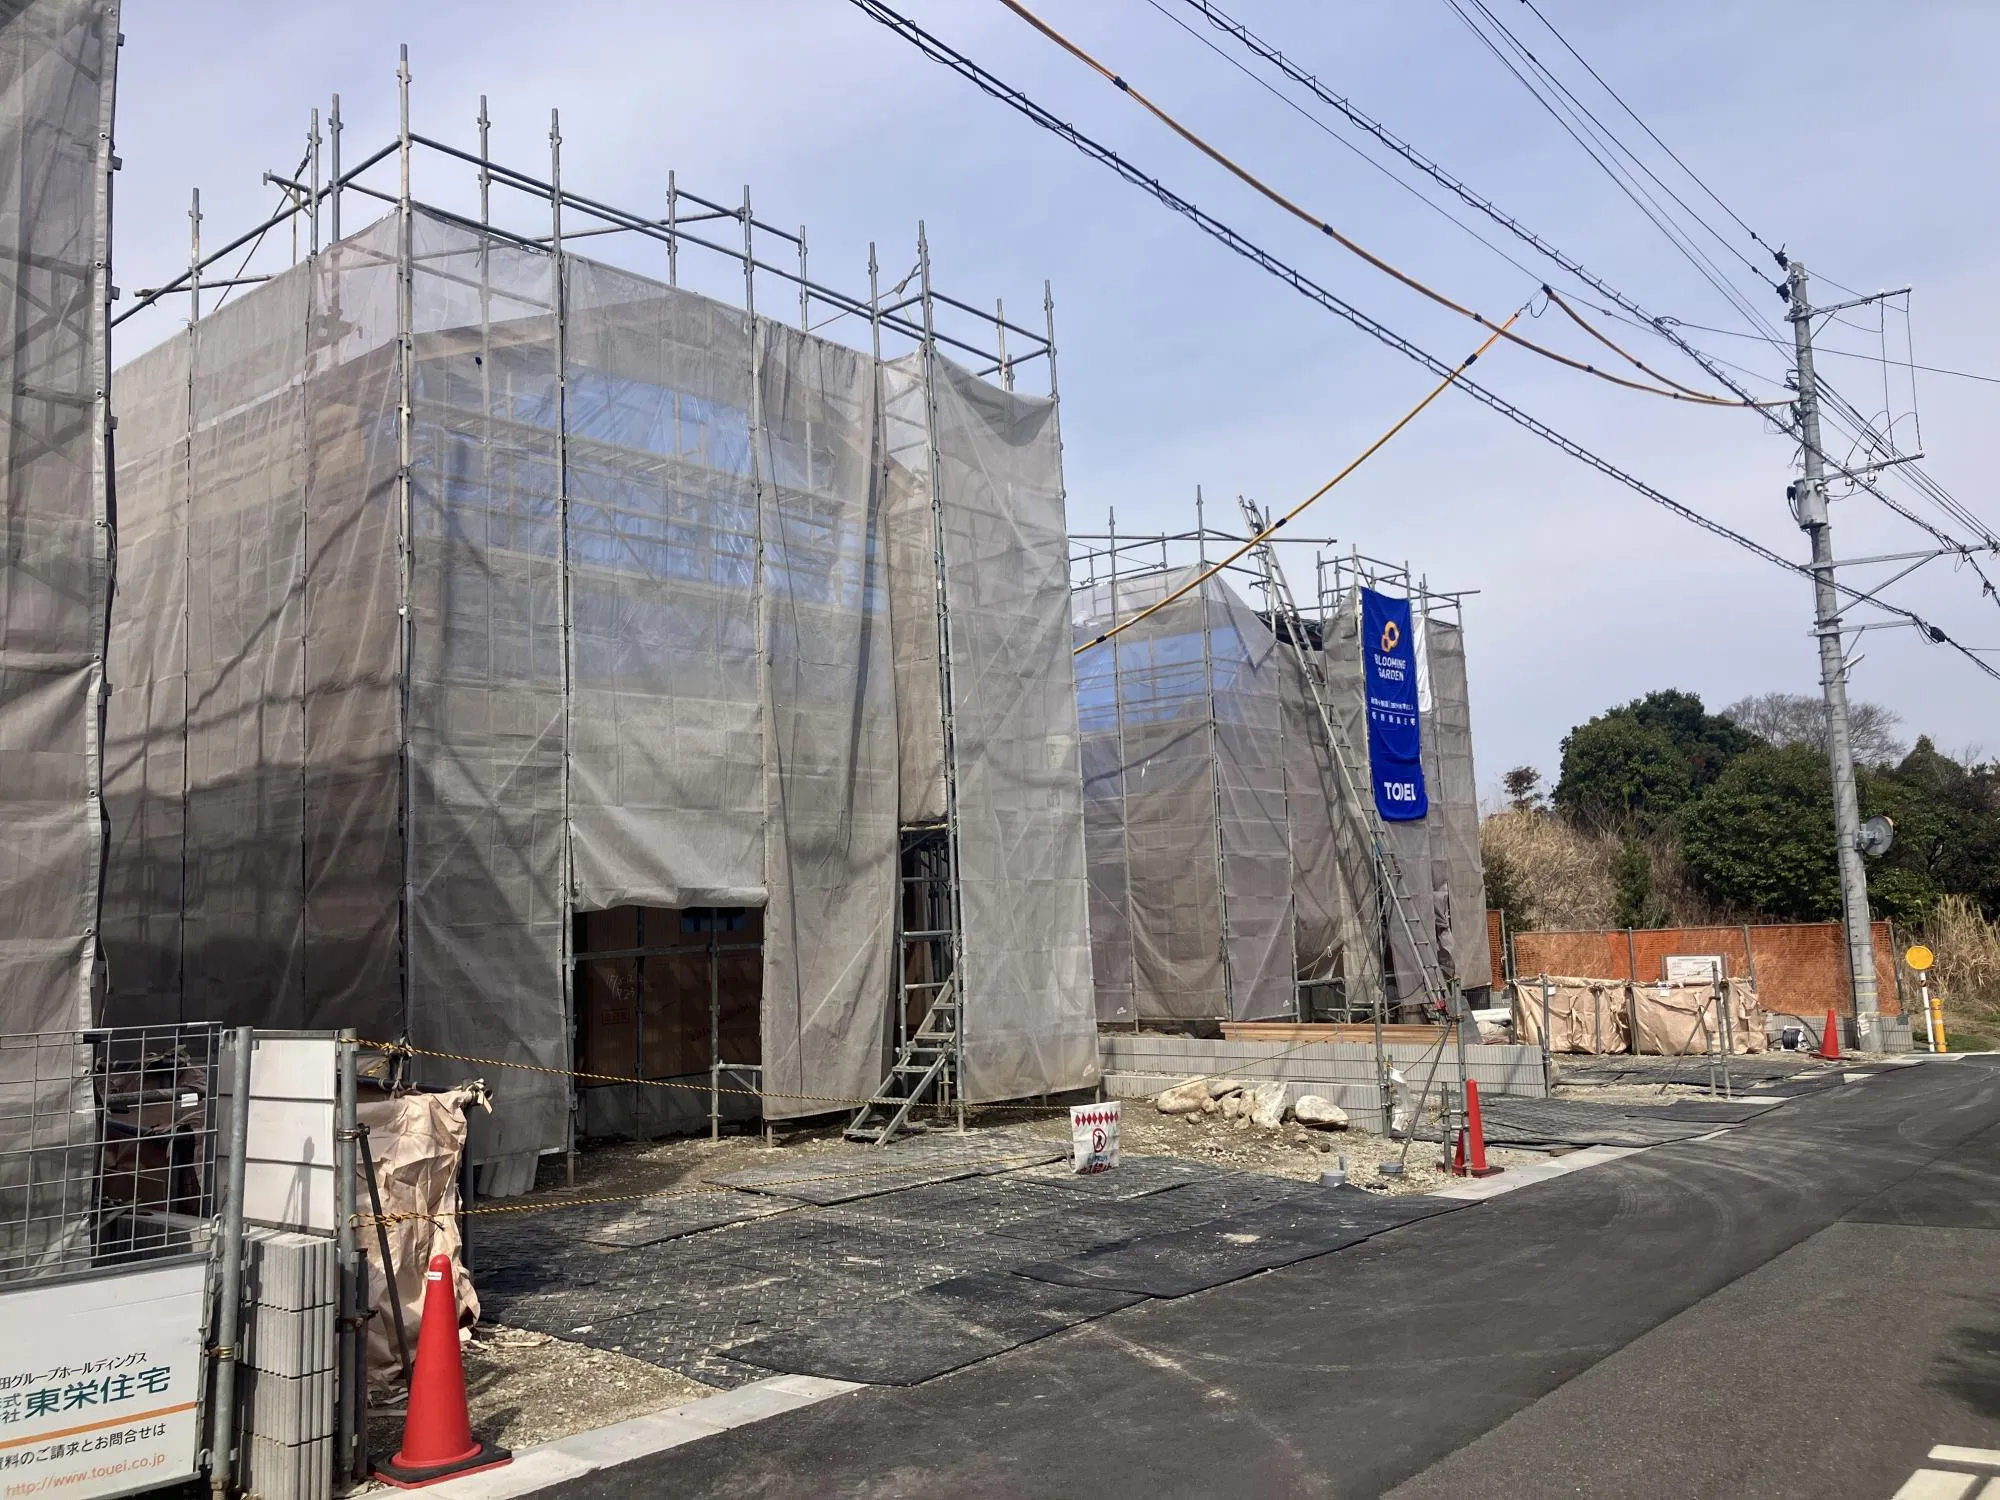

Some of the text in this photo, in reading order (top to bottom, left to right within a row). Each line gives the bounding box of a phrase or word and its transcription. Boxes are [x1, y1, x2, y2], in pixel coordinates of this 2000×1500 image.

[1374, 653, 1406, 670] BLOOMING
[1378, 667, 1404, 682] GARDEN
[24, 1366, 171, 1419] 東栄住宅
[0, 1408, 20, 1424] 社
[6, 1452, 165, 1498] http://www.touei.co.jp
